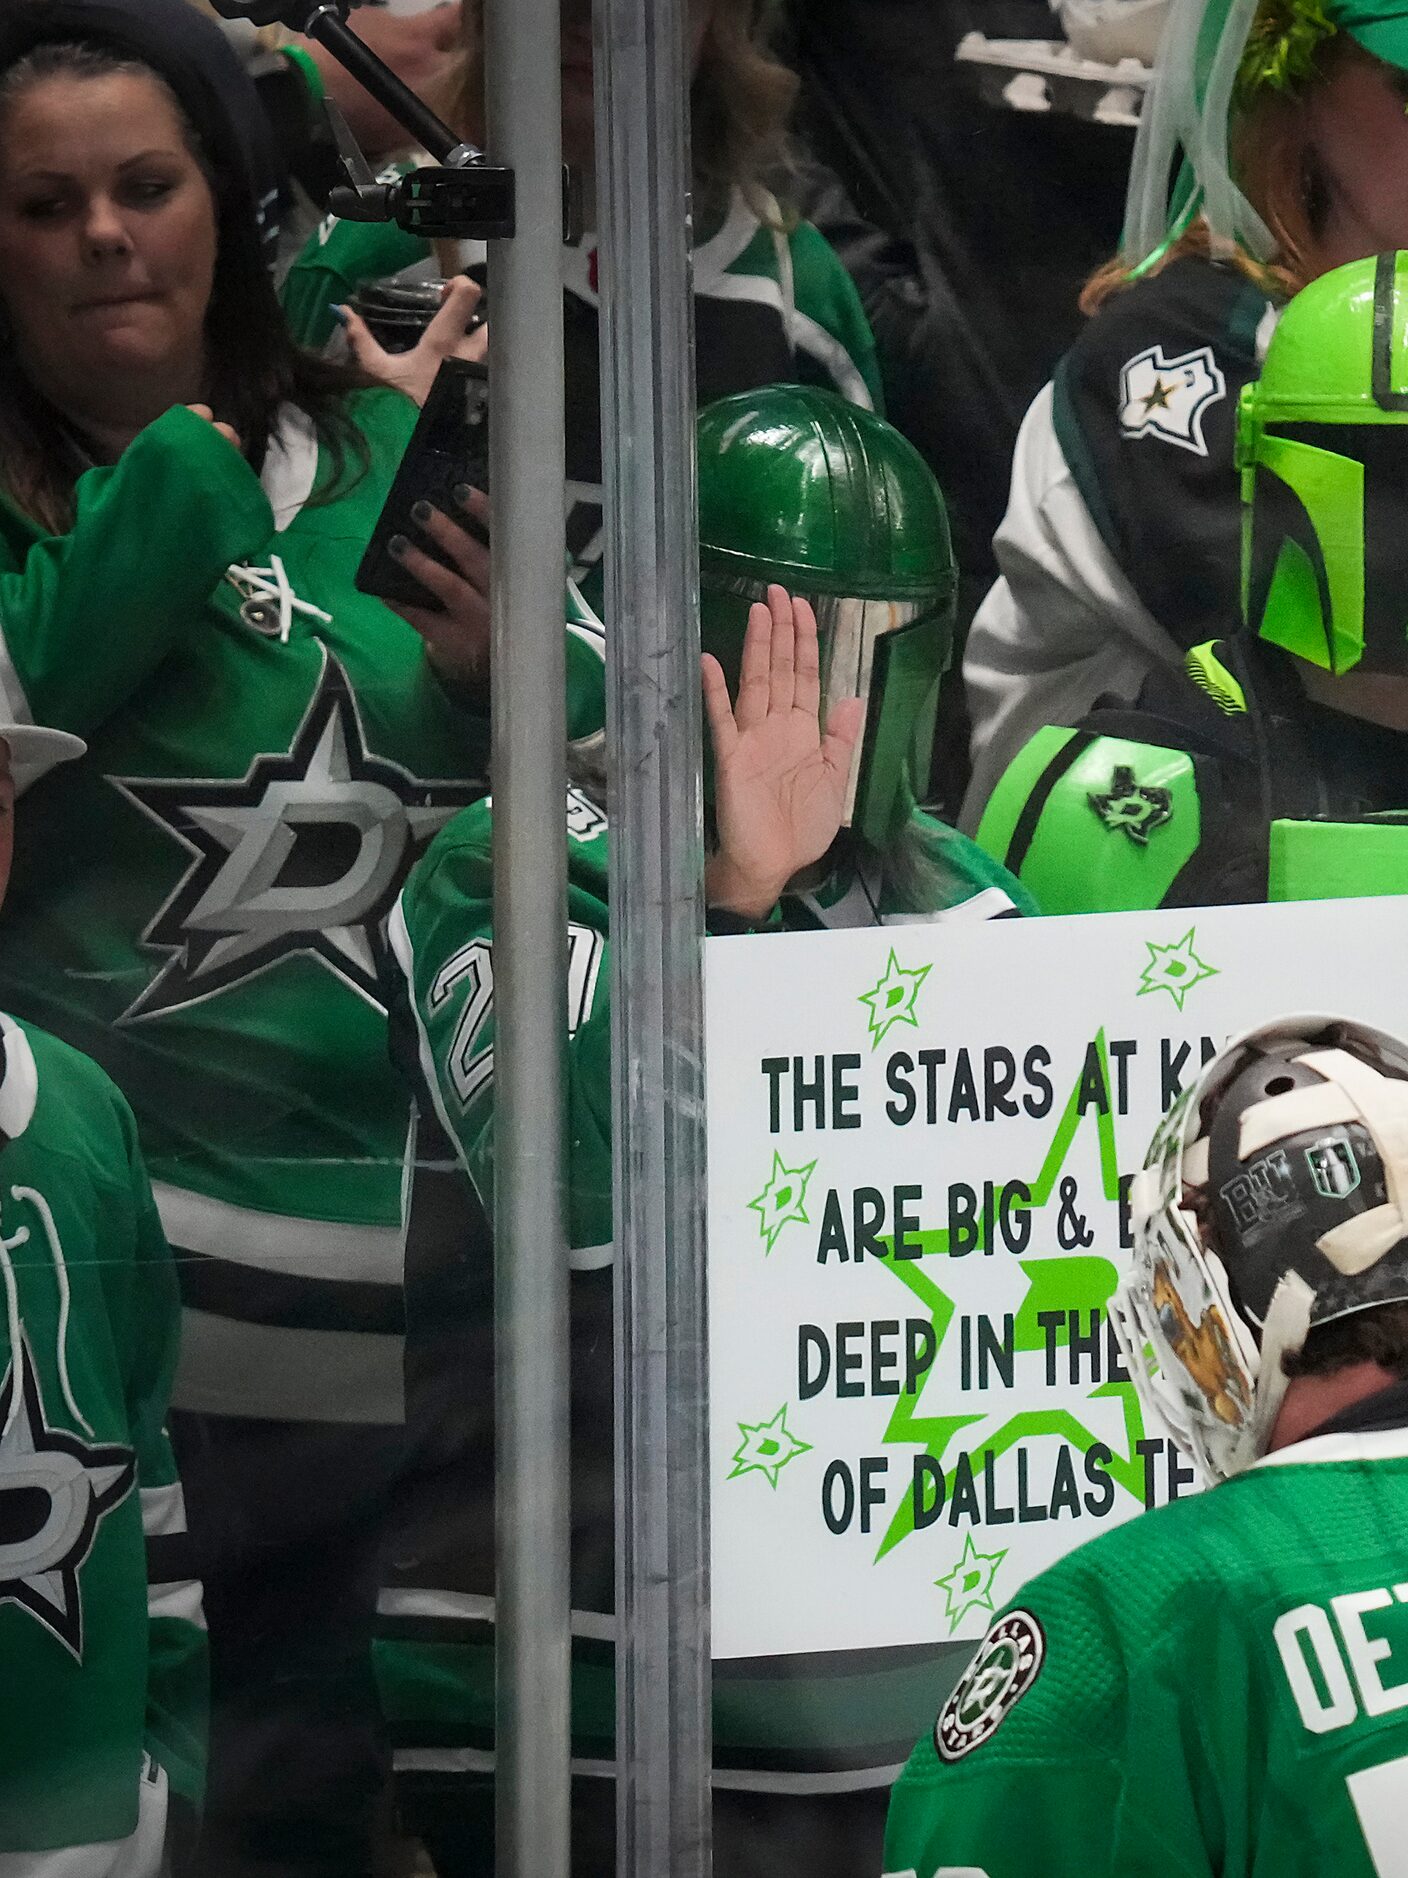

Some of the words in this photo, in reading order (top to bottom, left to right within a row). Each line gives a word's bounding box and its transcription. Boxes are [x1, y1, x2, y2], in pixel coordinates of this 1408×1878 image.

[762, 1054, 861, 1133] THE
[886, 1045, 1053, 1125] STARS
[1077, 1040, 1136, 1116] AT
[817, 1185, 922, 1264] ARE
[948, 1180, 1031, 1257] BIG
[1058, 1176, 1094, 1250] &
[799, 1319, 936, 1400] DEEP
[961, 1314, 1014, 1390] IN
[822, 1457, 888, 1534] OF
[913, 1442, 1114, 1530] DALLAS
